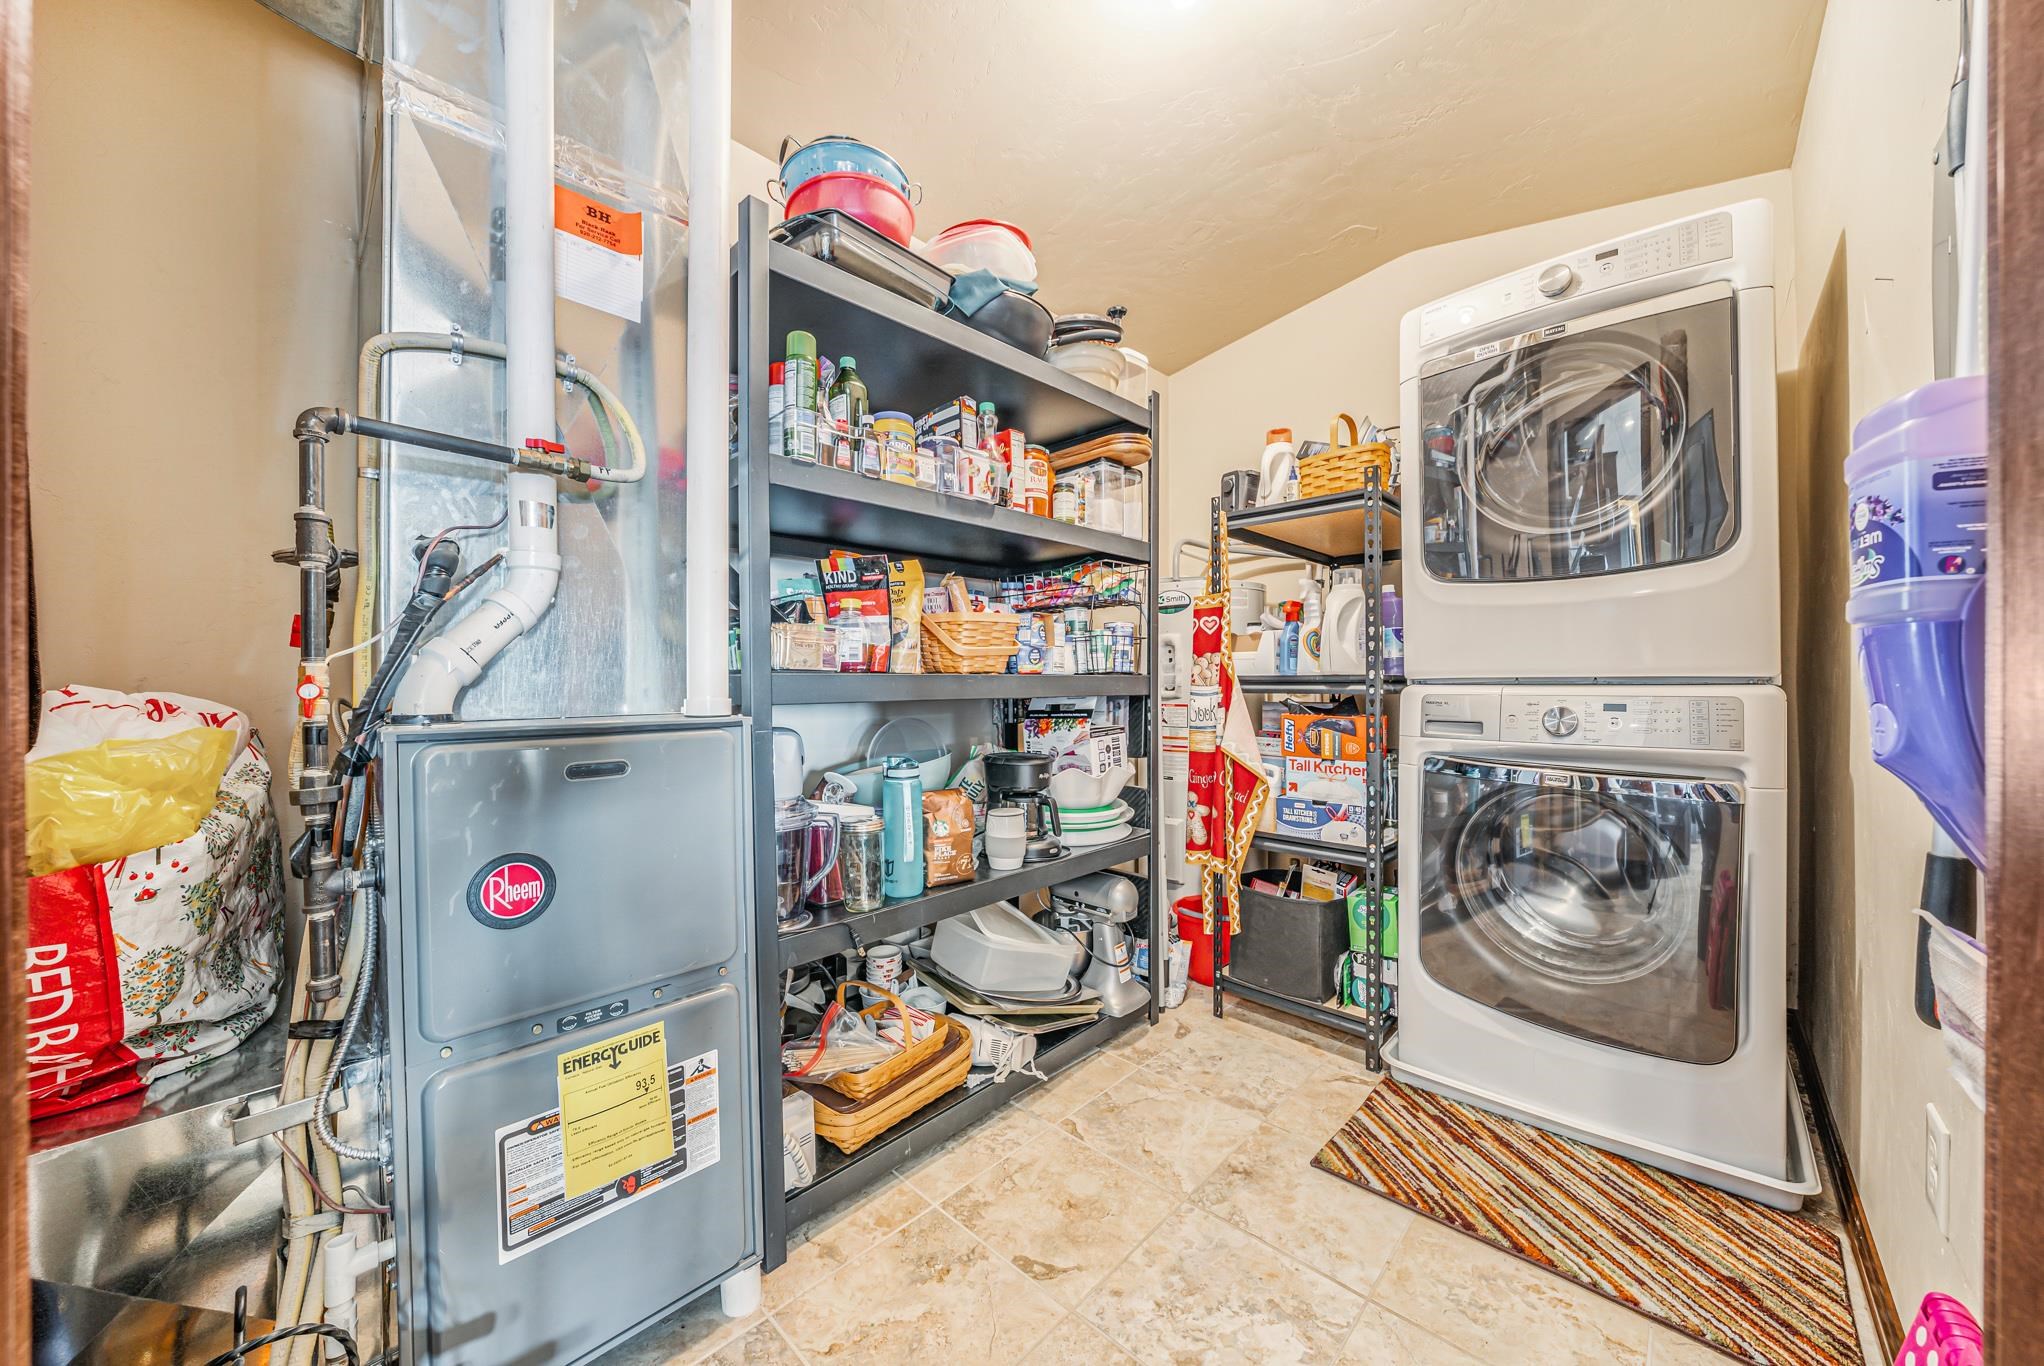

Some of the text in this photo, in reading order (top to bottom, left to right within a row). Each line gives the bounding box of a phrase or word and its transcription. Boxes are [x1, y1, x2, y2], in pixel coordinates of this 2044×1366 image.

[586, 205, 611, 224] BH
[824, 569, 857, 584] KIND
[1165, 595, 1186, 603] Smith
[1285, 721, 1294, 751] Hefty
[1288, 758, 1311, 772] Tall
[489, 866, 541, 911] Rheem
[563, 1030, 661, 1075] ENERGYGUIDE
[635, 1074, 656, 1090] 93.5
